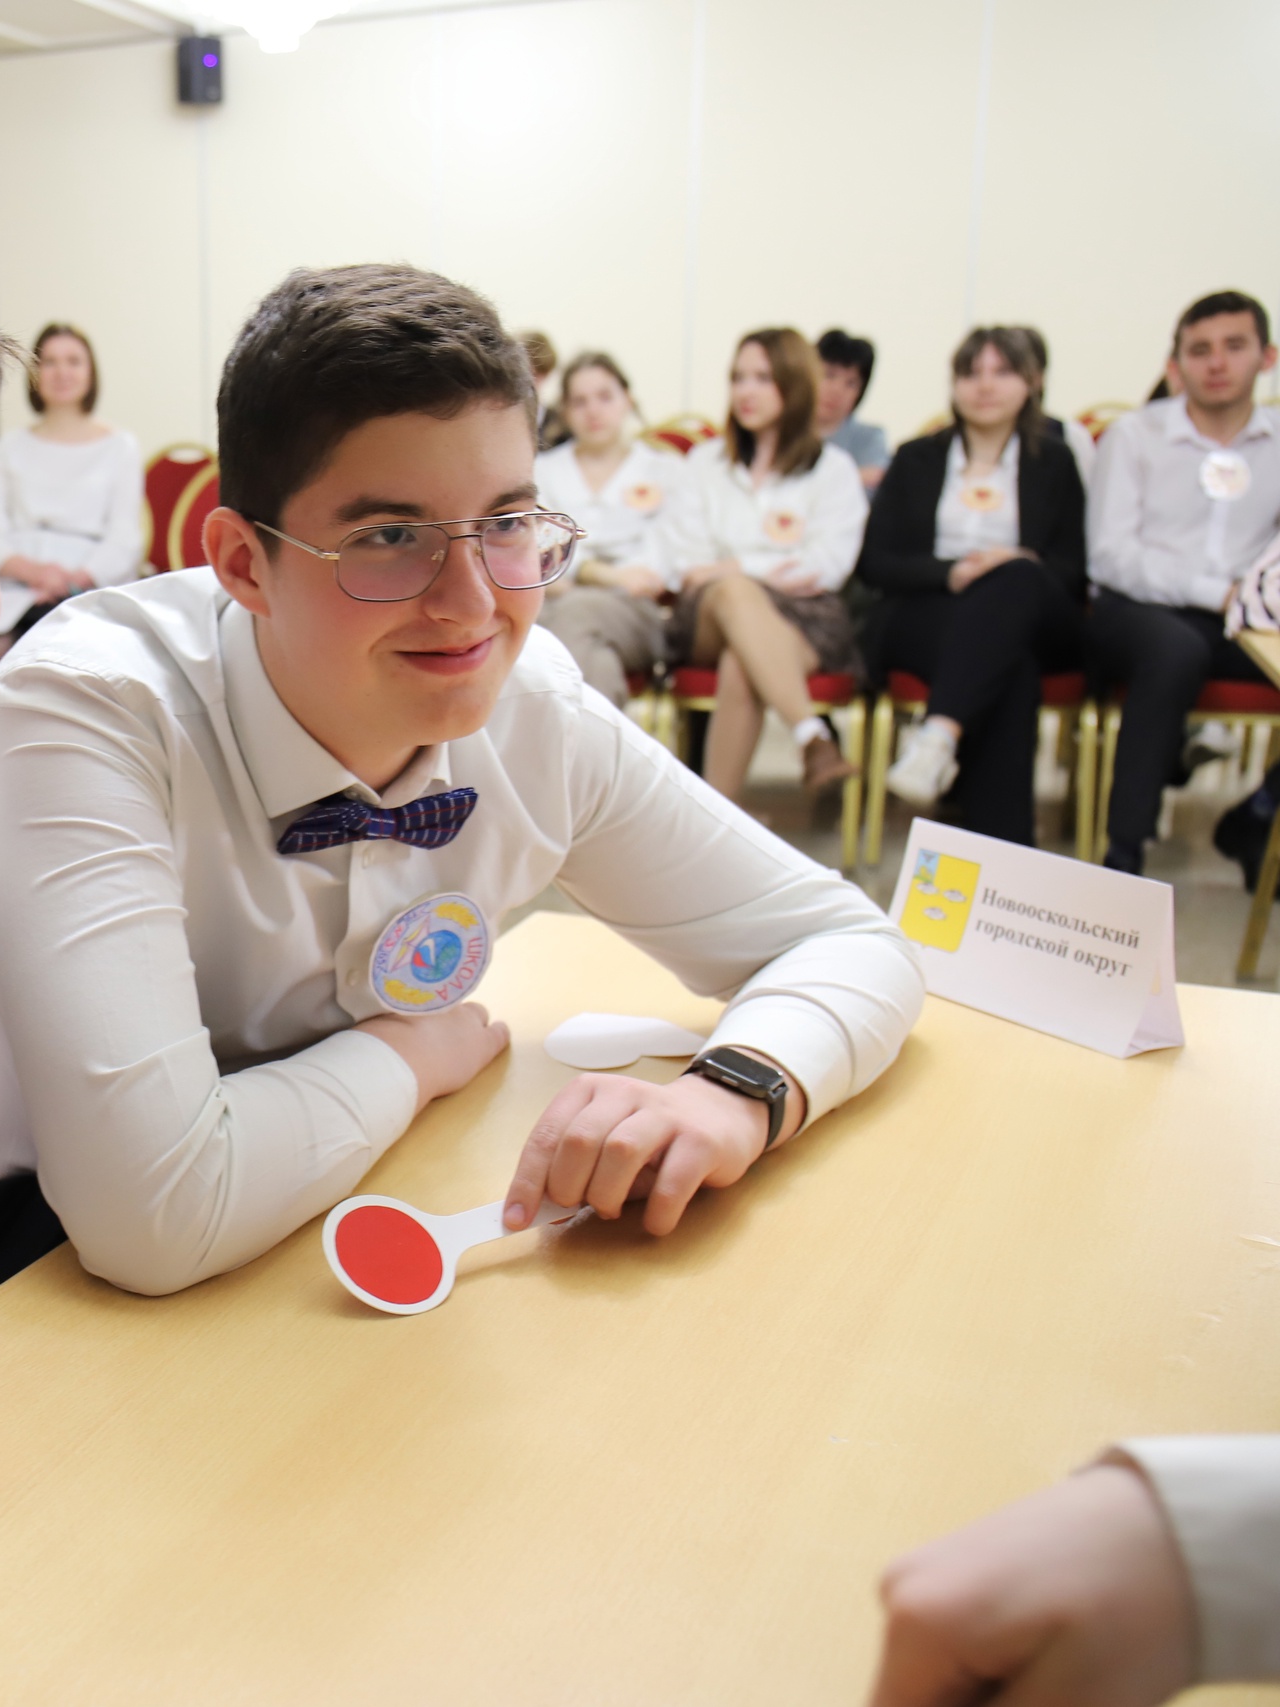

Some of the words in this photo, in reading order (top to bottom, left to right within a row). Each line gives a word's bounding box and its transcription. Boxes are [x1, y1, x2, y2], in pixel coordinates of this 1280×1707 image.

[975, 917, 1069, 959] городской
[1074, 949, 1132, 978] округ
[981, 887, 1140, 949] Новооскольский
[435, 936, 483, 1001] ШКОЛА
